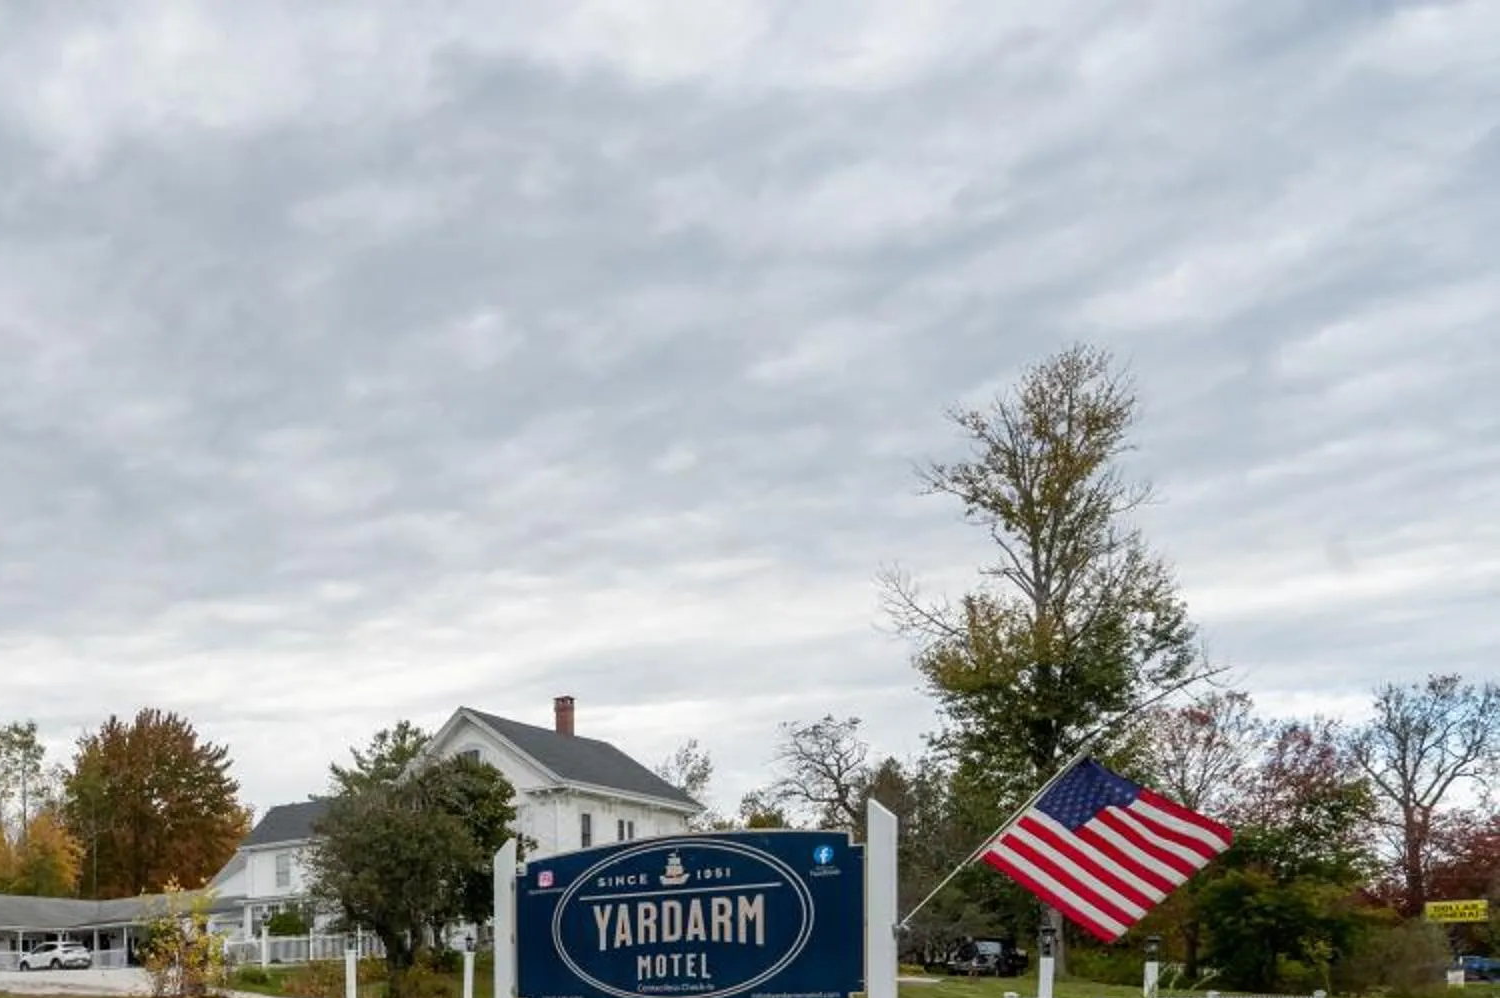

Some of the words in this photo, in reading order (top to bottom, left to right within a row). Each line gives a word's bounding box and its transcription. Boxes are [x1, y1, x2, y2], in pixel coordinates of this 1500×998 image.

[597, 873, 649, 888] SINCE
[592, 893, 765, 952] YARDARM
[636, 952, 712, 981] MOTEL
